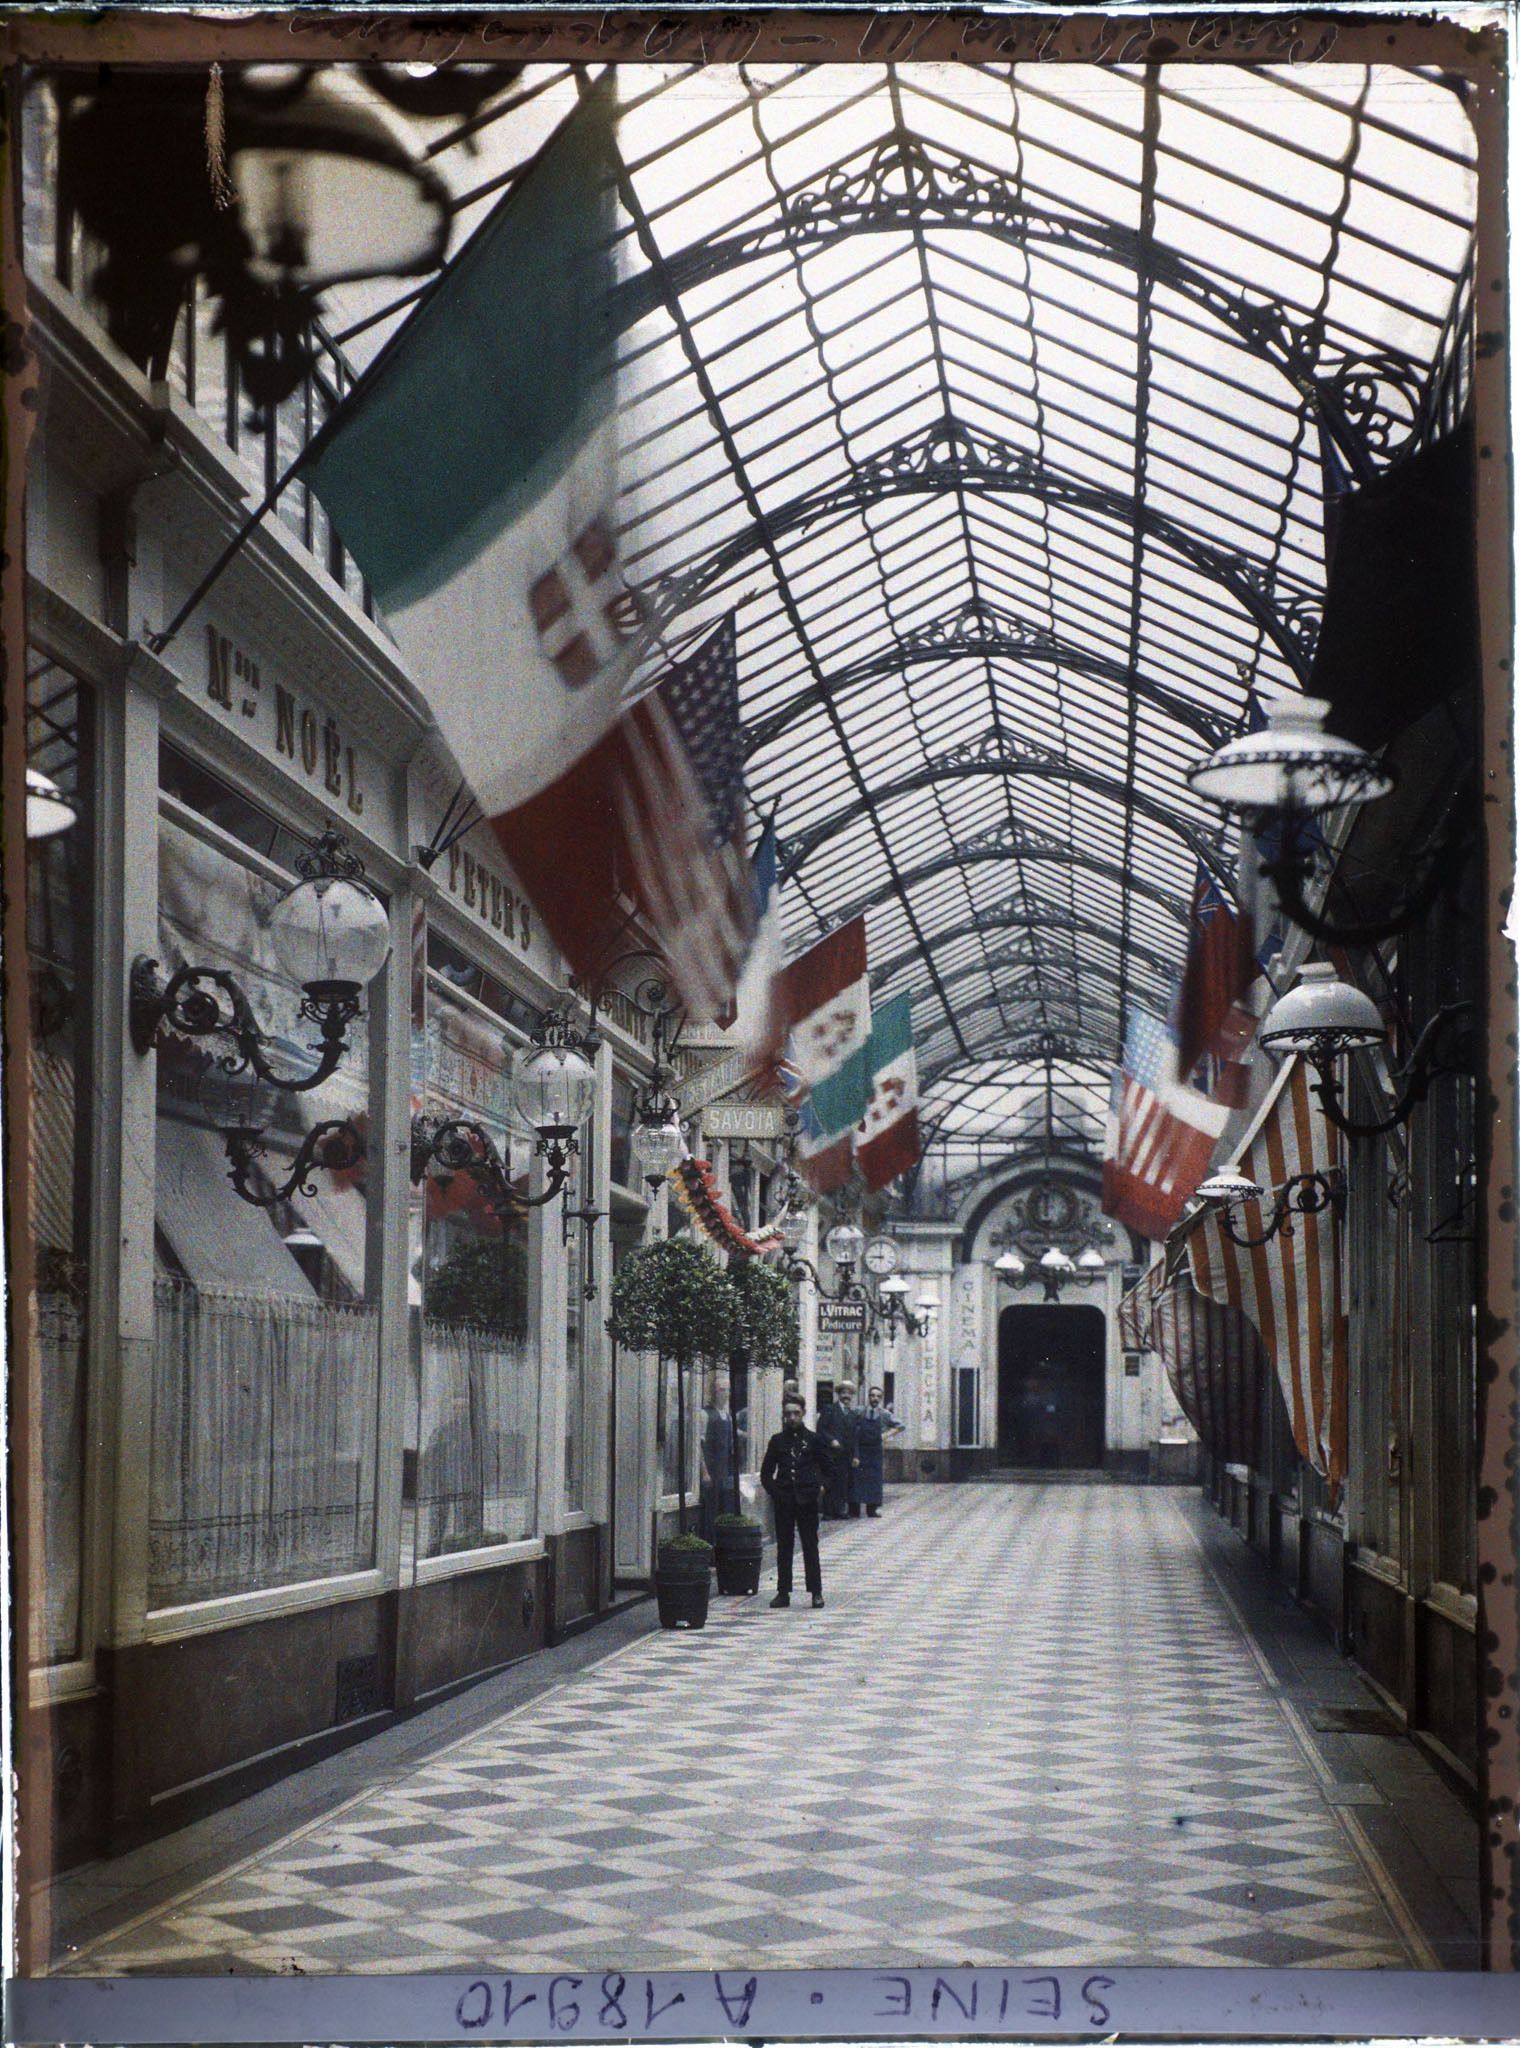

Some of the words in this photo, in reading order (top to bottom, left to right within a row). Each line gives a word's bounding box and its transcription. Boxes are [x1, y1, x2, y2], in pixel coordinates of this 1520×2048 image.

[275, 684, 363, 816] NOËL
[710, 1110, 774, 1130] SAVOIA
[870, 1974, 1116, 2026] SEINE
